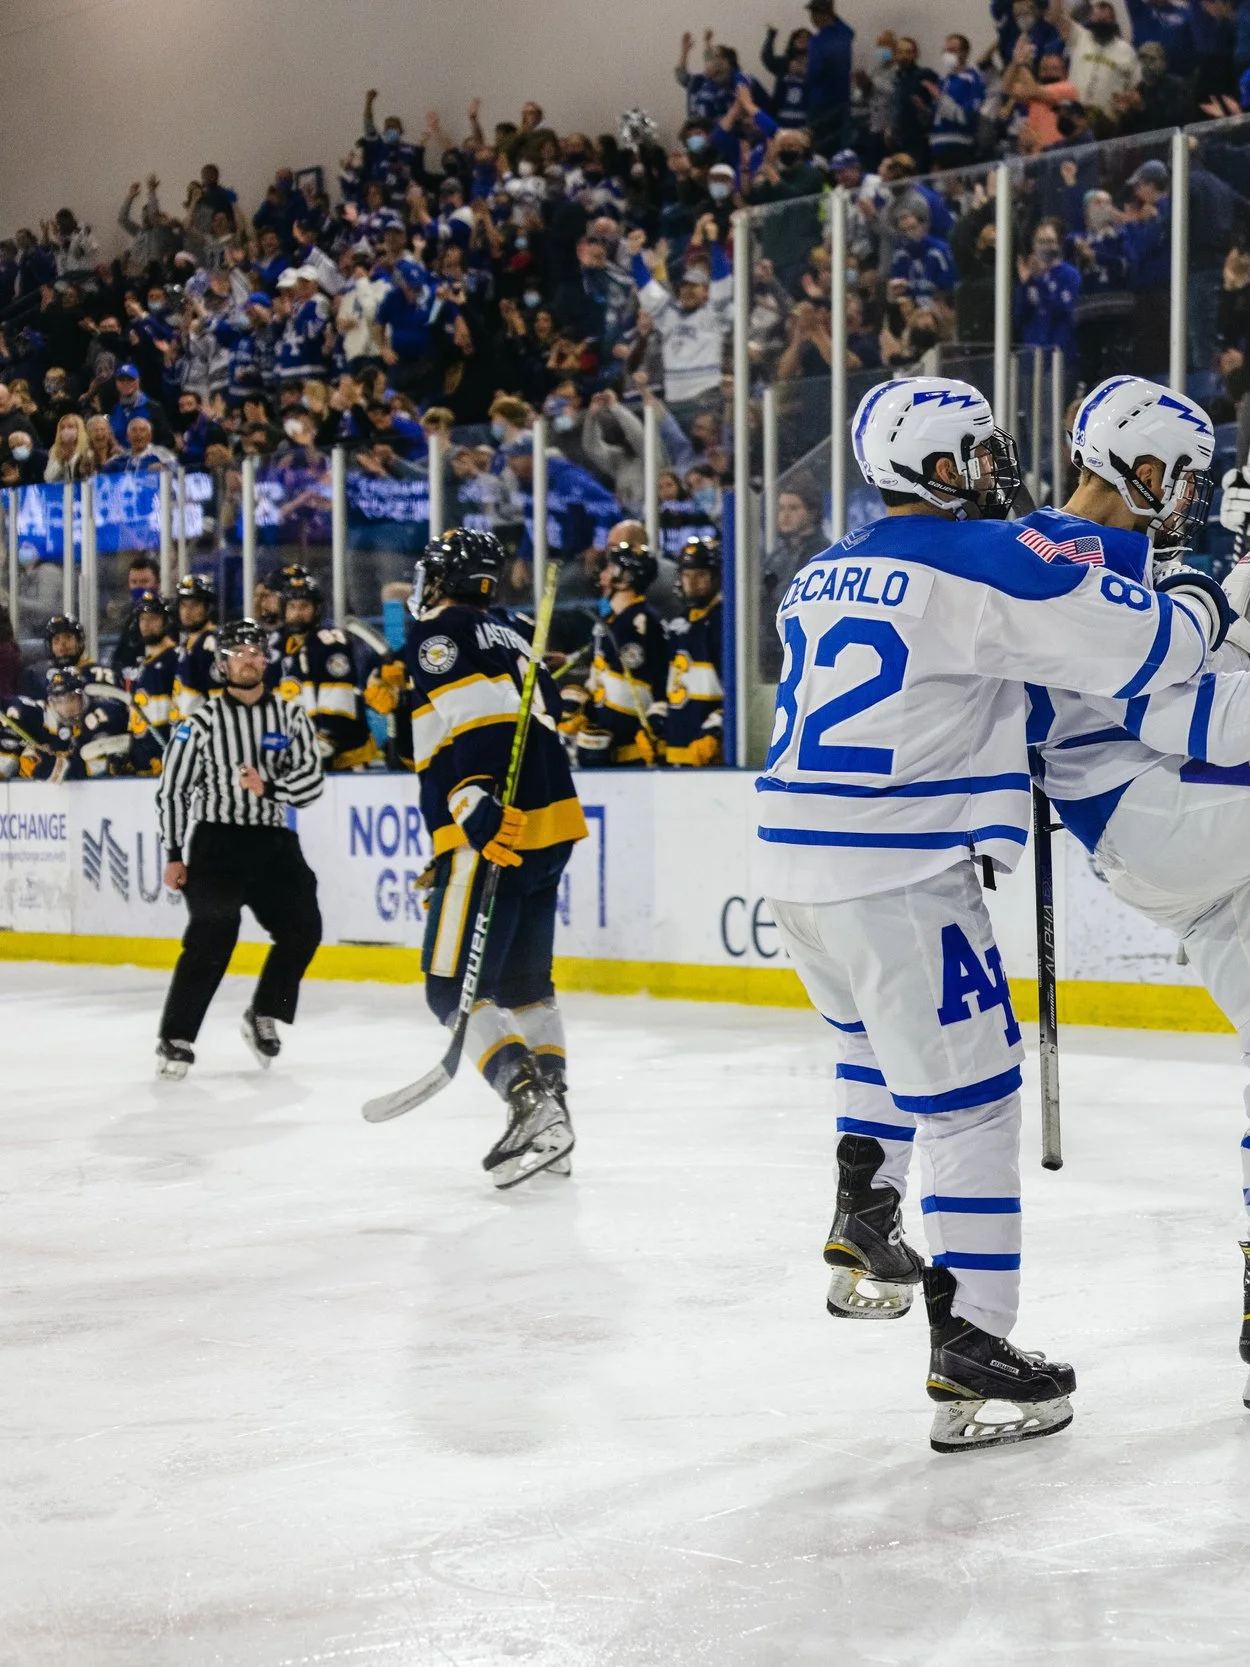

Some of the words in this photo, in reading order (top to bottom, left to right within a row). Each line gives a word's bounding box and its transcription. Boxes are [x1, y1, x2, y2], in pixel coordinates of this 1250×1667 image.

[927, 480, 957, 494] BAUER
[1132, 479, 1155, 503] BAUER
[1101, 574, 1151, 612] 8
[765, 616, 909, 775] 82
[350, 804, 434, 857] NOR
[461, 913, 490, 1014] BAUER
[1044, 904, 1056, 978] ALPHA
